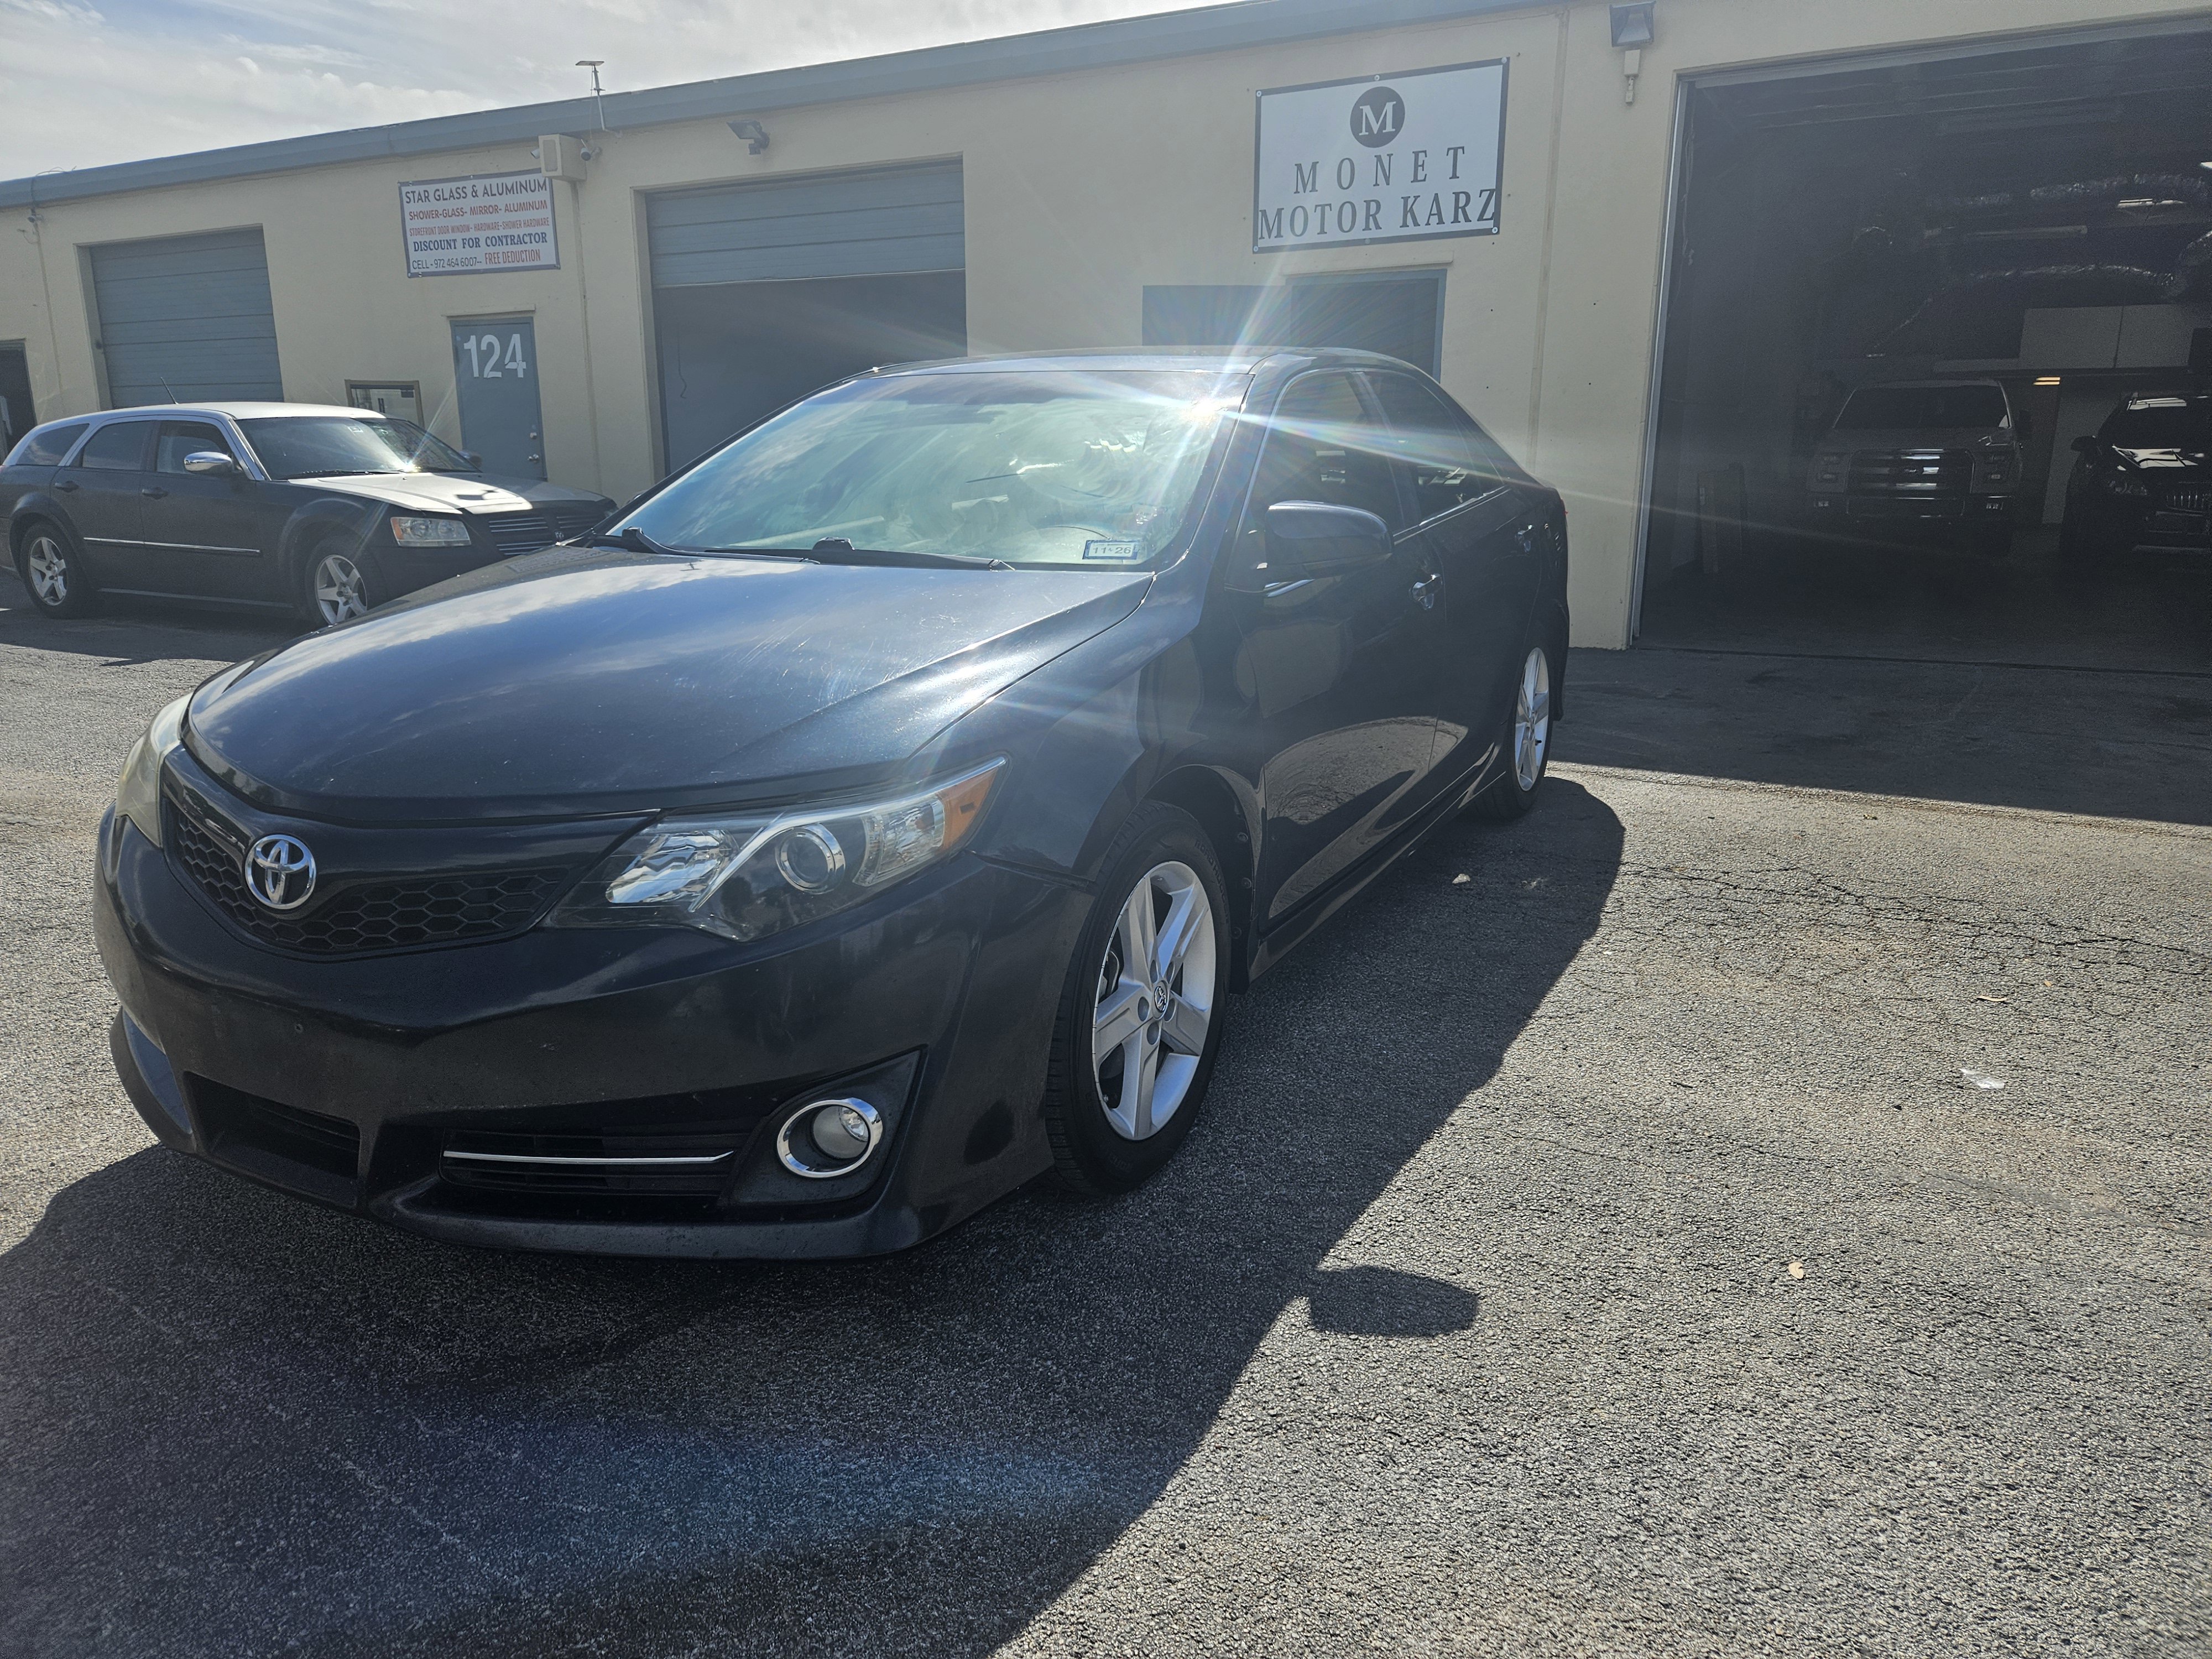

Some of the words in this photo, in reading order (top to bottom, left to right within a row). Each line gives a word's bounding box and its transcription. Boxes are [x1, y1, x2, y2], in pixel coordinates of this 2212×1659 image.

[1359, 101, 1396, 135] M
[1293, 146, 1465, 194] MONET
[405, 190, 430, 204] STAR
[434, 186, 467, 201] GLASS
[471, 184, 479, 198] &
[482, 178, 547, 197] ALUMINUM
[470, 204, 502, 216] MIRROR-
[504, 200, 547, 212] ALUMINUM
[1259, 199, 1382, 240] MOTOR
[1399, 188, 1496, 228] KARZ
[409, 226, 436, 237] STOREFRONT
[437, 225, 450, 235] DOOR
[523, 217, 550, 228] HARDWARE
[413, 239, 457, 252] DISCOUNT
[461, 237, 481, 249] FOR
[485, 232, 547, 247] CONTRACTOR
[412, 259, 429, 269] CELL
[434, 259, 446, 268] 972
[447, 258, 459, 267] 464
[484, 252, 501, 264] FREE
[502, 249, 540, 264] DEDUCTION
[463, 334, 526, 378] 124
